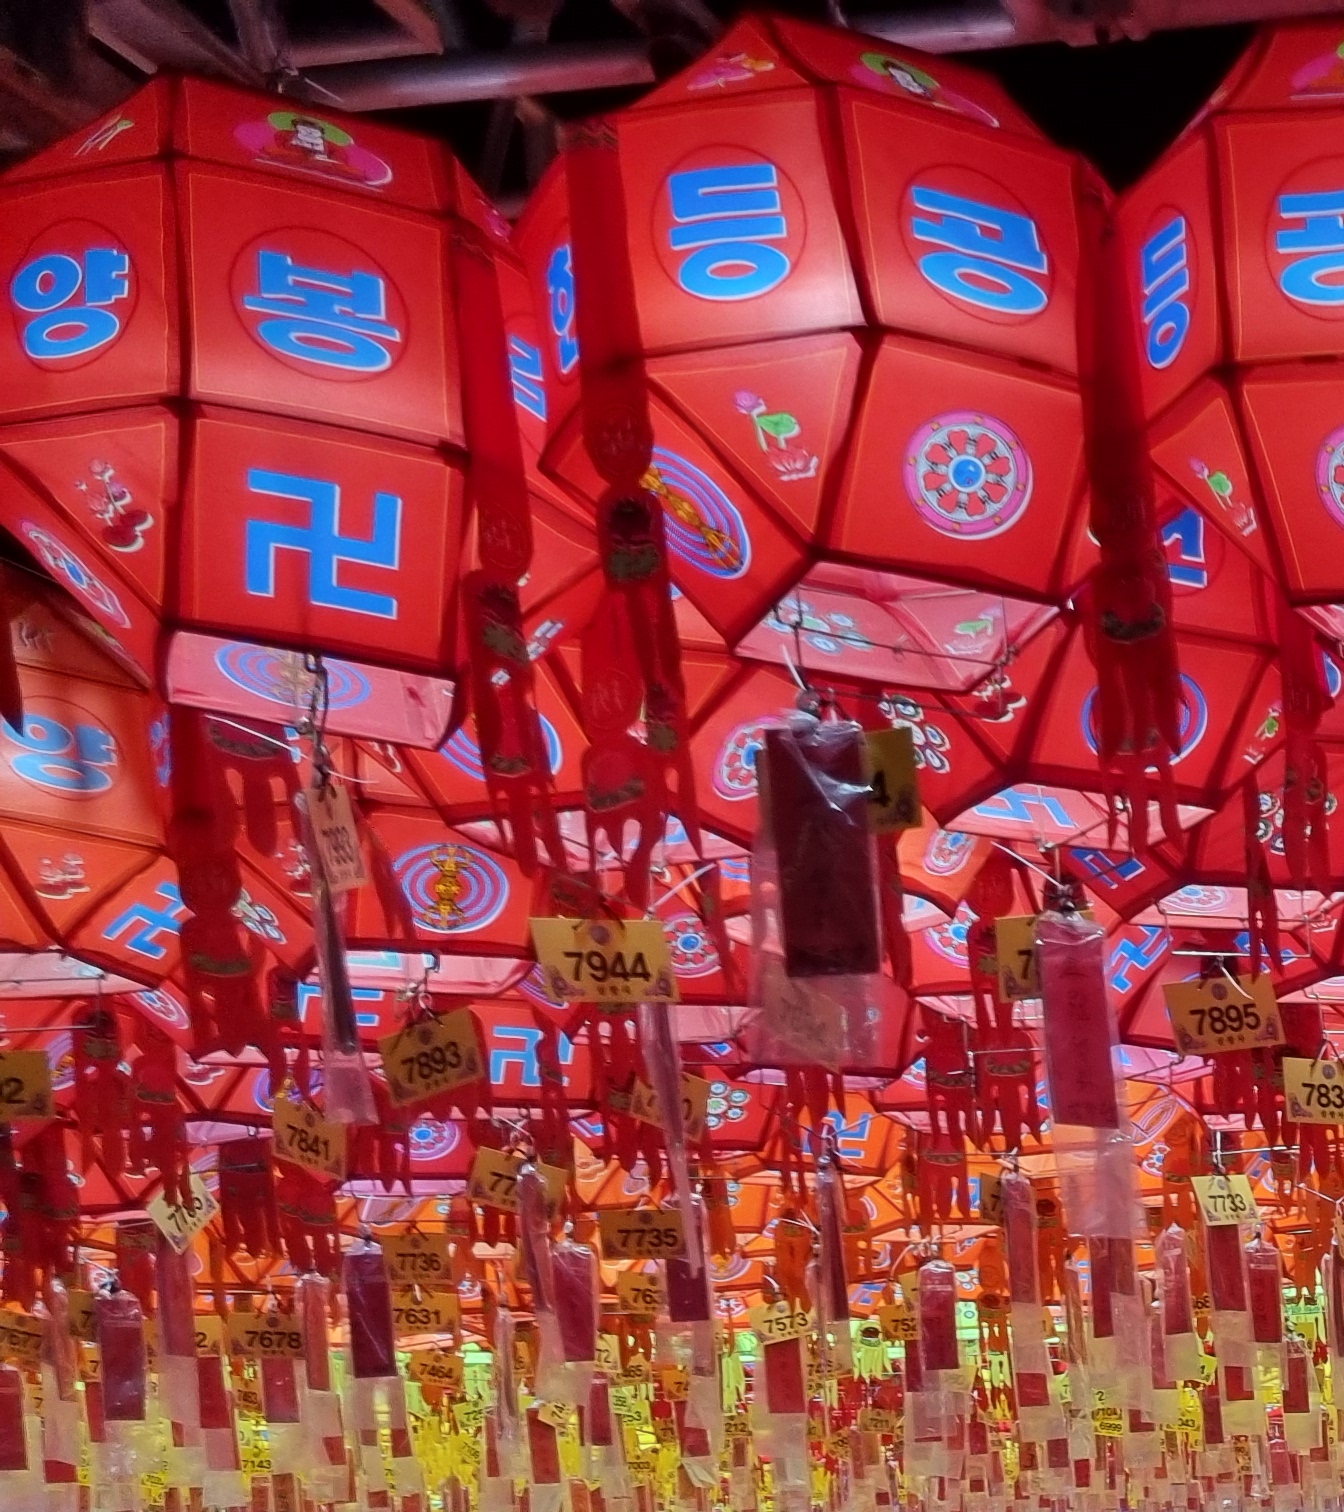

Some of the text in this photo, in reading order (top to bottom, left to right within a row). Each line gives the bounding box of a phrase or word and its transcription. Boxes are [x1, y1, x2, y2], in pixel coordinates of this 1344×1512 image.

[667, 163, 791, 301] 등
[909, 186, 1049, 315] 공
[13, 248, 129, 360] 양
[1141, 215, 1191, 370] 등
[244, 250, 401, 372] 봉
[563, 950, 652, 983] 7944
[1190, 1004, 1261, 1035] 7895
[401, 1045, 462, 1083] 7893
[288, 1123, 332, 1162] 7841
[1207, 1192, 1247, 1214] 7733
[617, 1228, 680, 1251] 7735
[396, 1256, 442, 1278] 7736
[393, 1307, 442, 1326] 7631
[763, 1310, 809, 1336] 7573
[245, 1329, 303, 1350] 7678
[420, 1359, 455, 1381] 7464
[242, 1458, 273, 1471] 7143
